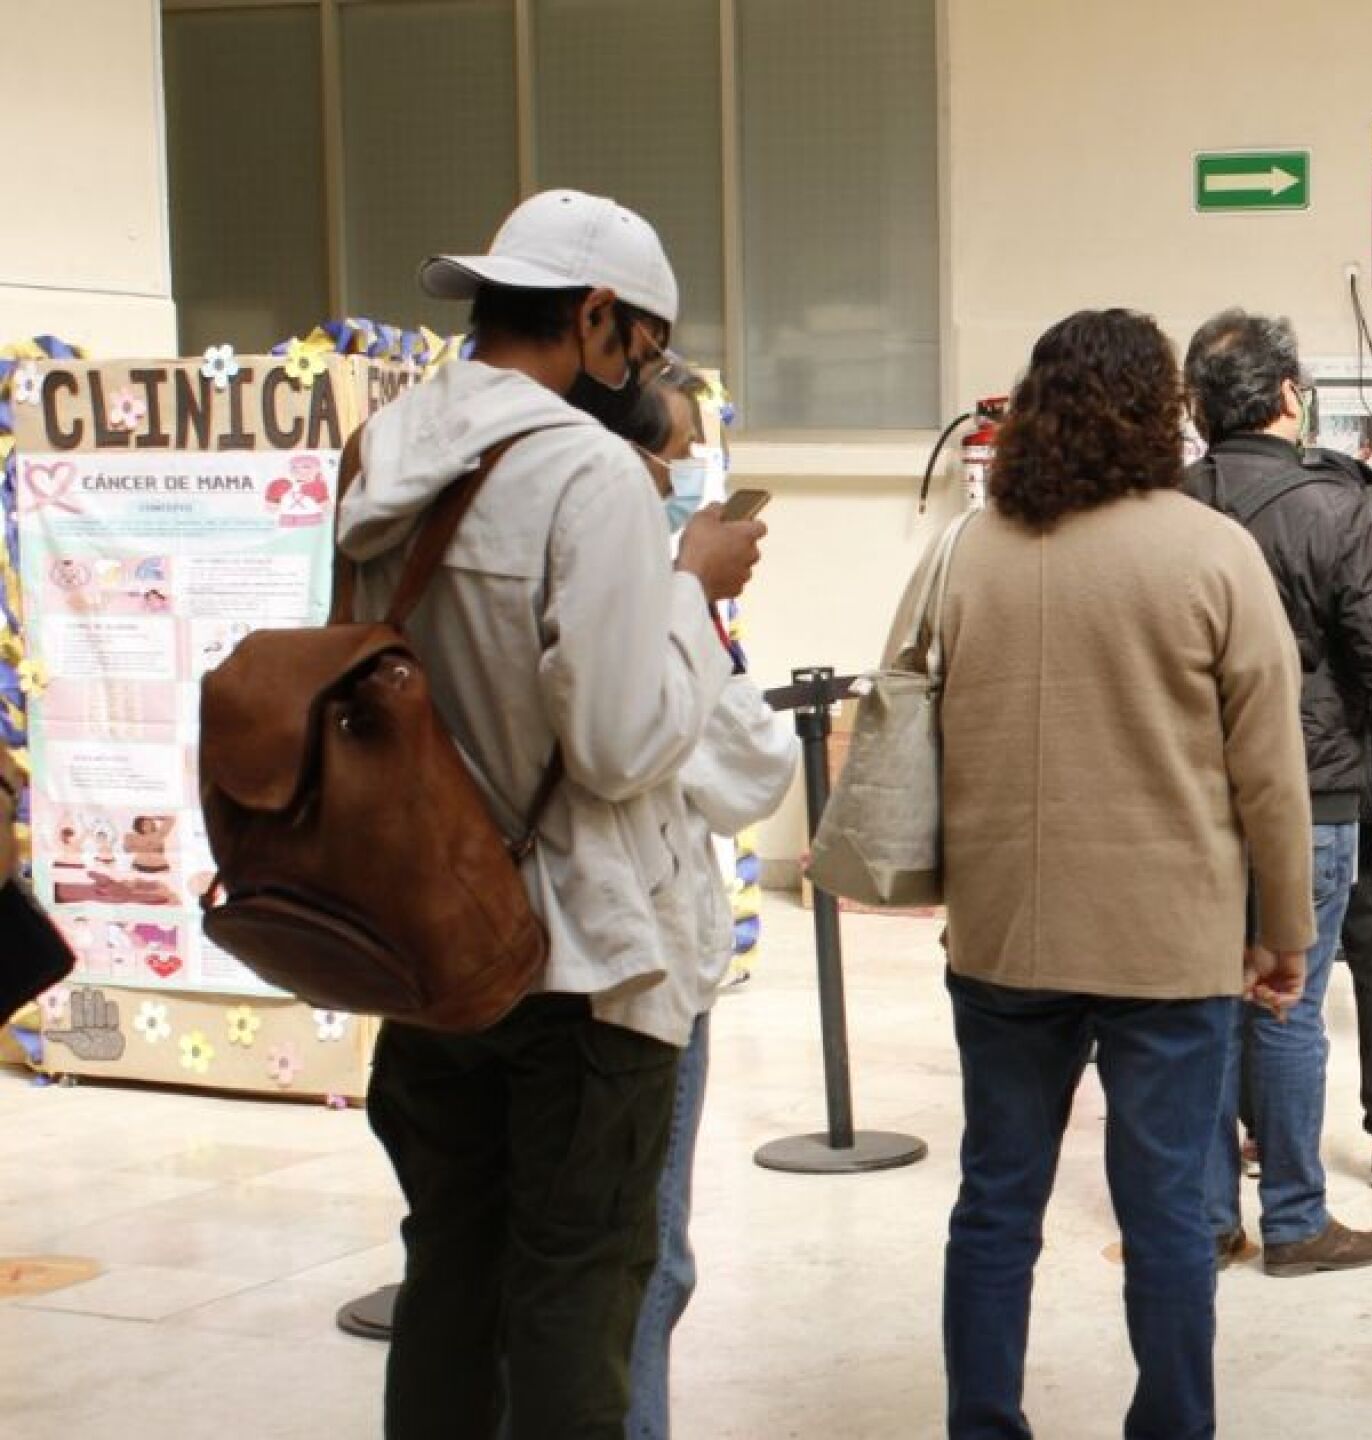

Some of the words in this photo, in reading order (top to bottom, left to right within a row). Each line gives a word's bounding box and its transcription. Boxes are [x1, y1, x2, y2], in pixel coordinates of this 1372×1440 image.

[42, 367, 343, 450] CLINICA
[81, 472, 158, 491] CÁNCER
[163, 474, 190, 490] DE
[196, 473, 256, 490] MAMA
